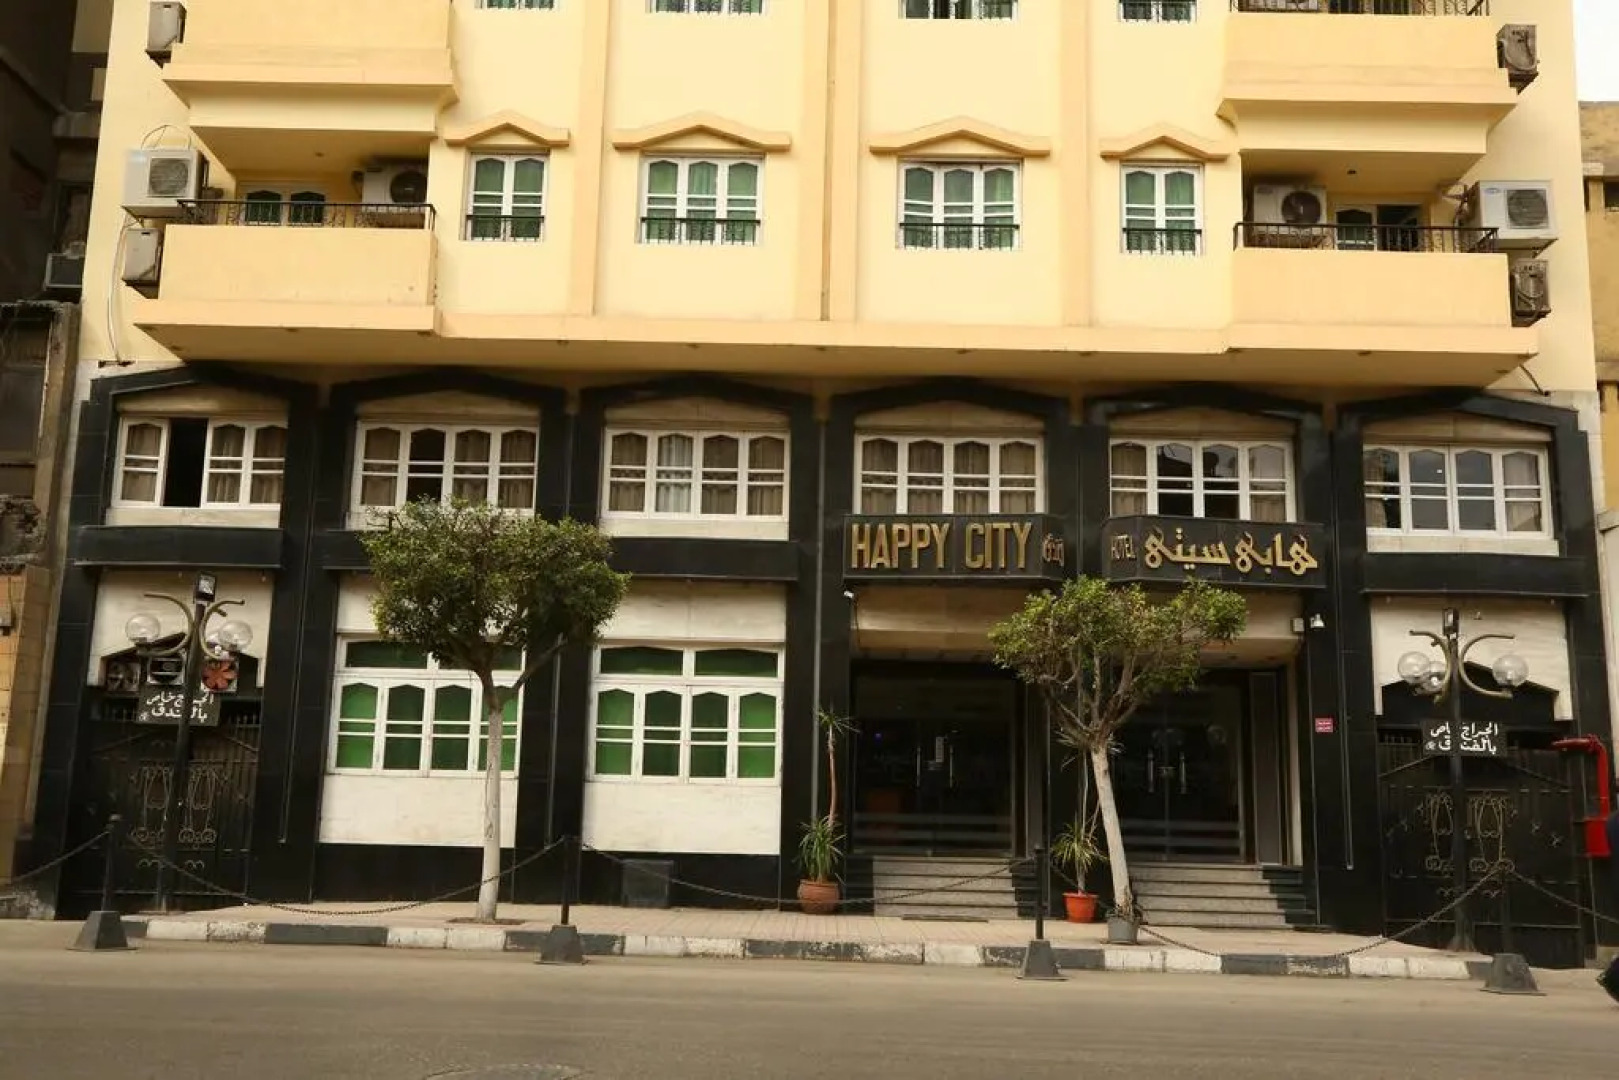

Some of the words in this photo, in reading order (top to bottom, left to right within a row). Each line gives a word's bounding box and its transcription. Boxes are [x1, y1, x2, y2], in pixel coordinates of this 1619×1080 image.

[851, 522, 950, 569] HAPPY
[965, 521, 1032, 569] CITY
[1430, 721, 1451, 737] اص
[1438, 735, 1497, 754] بالفنق
